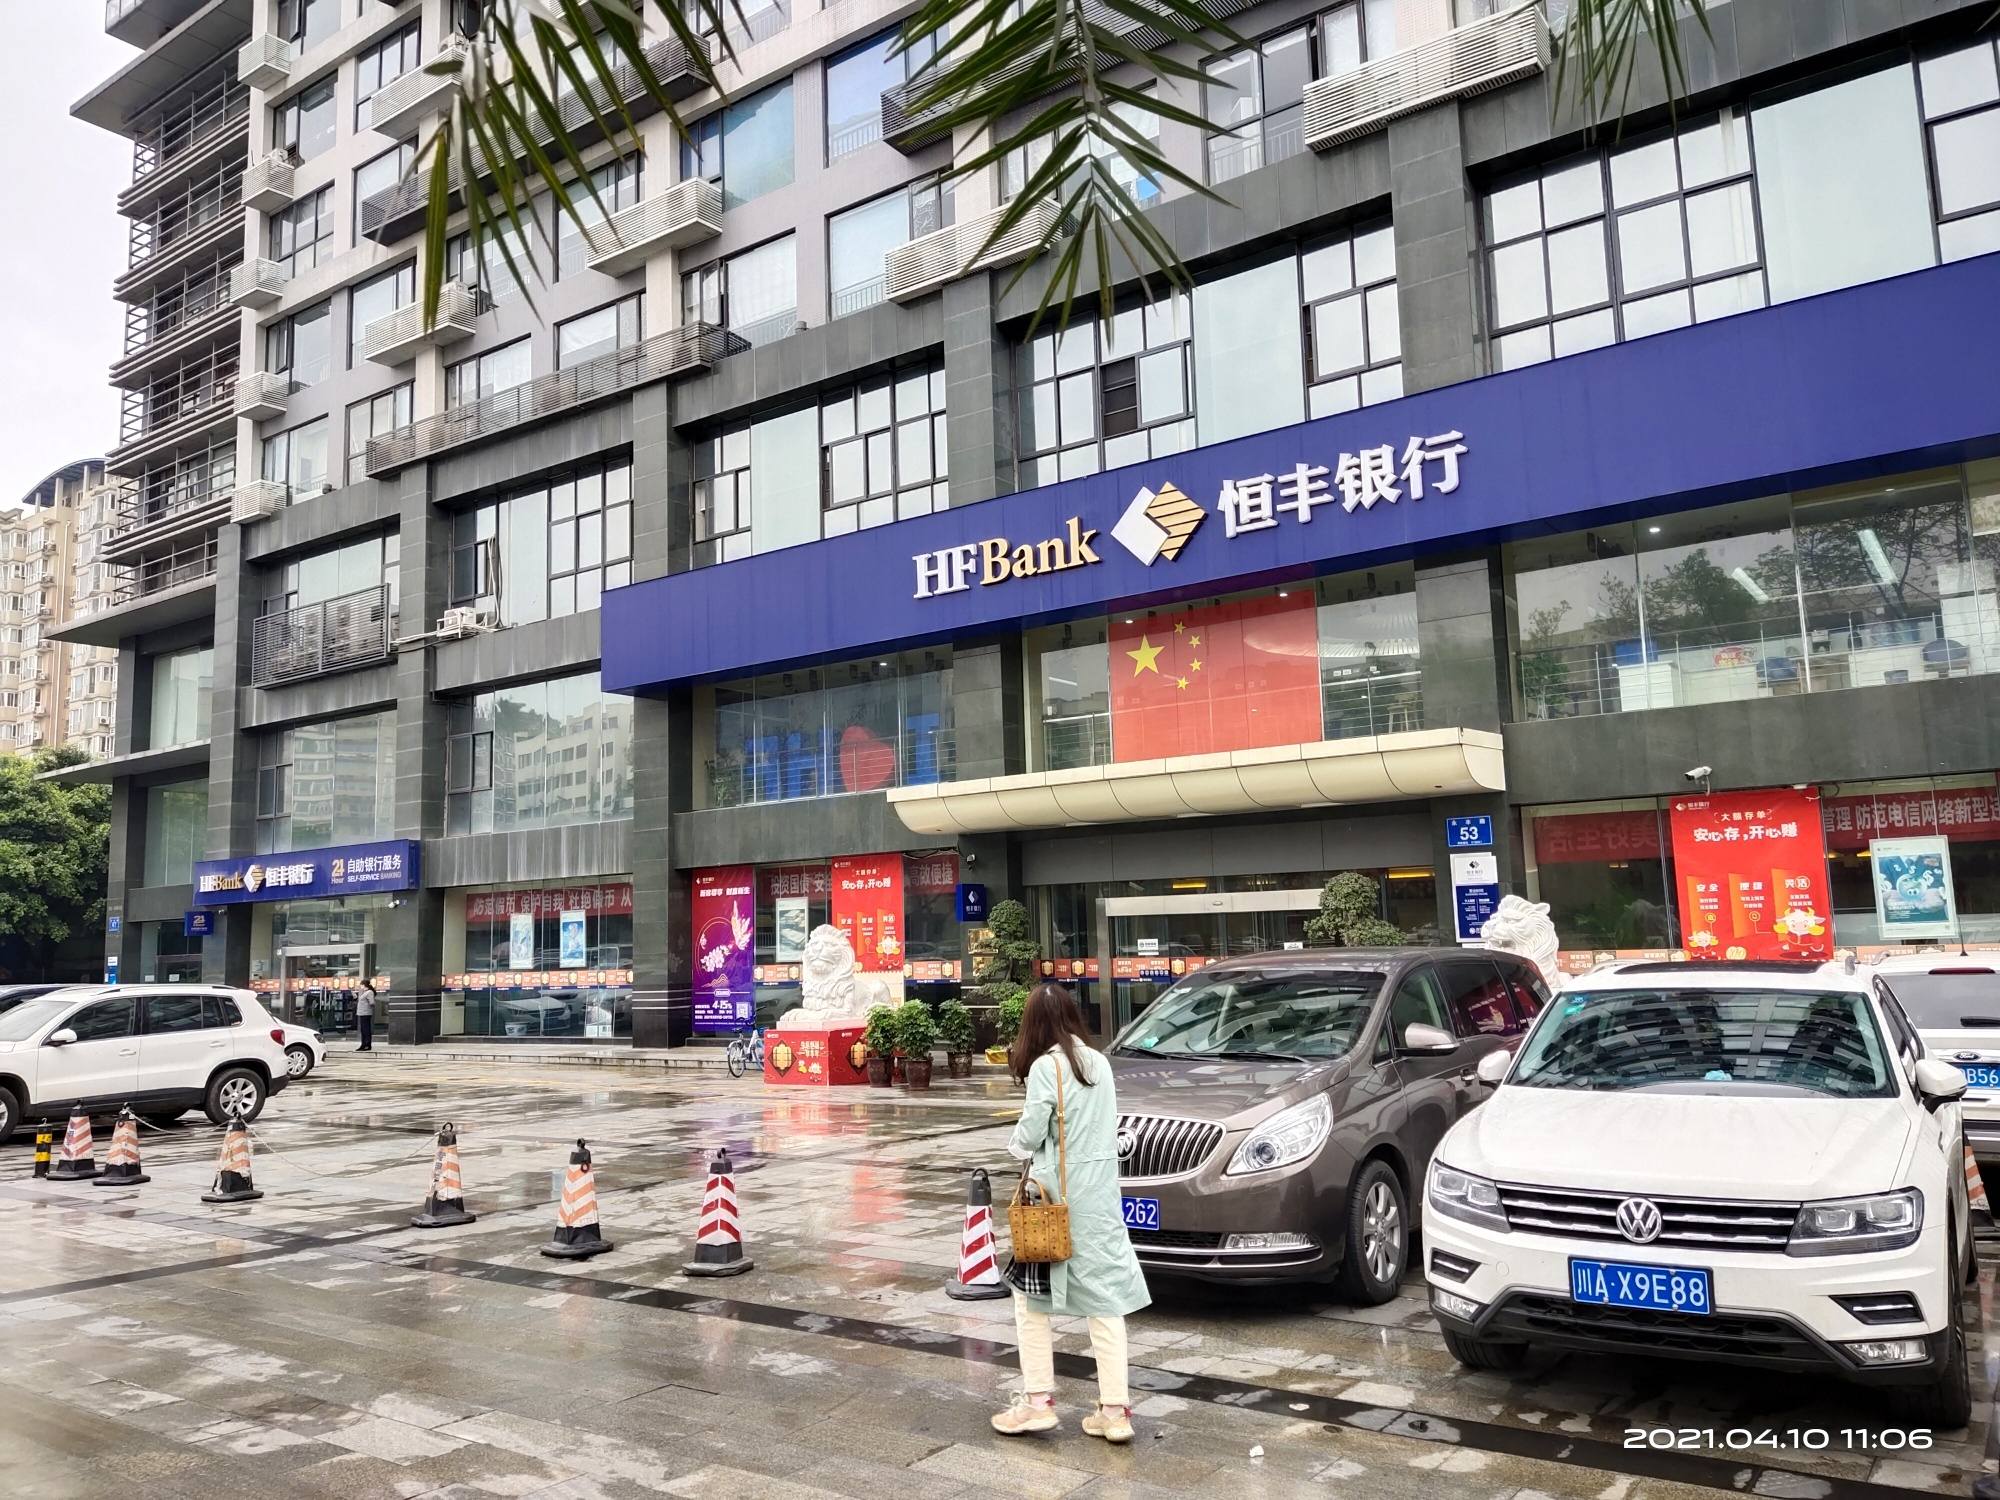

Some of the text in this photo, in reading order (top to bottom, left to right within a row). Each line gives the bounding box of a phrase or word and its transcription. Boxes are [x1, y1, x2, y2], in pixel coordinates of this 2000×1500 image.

[1217, 430, 1468, 538] 恒丰银行
[912, 516, 1100, 599] HFBank
[1460, 826, 1479, 840] 53
[331, 858, 345, 877] 24
[347, 854, 402, 874] 自助银行服务
[911, 862, 954, 886] 高效便捷
[199, 872, 241, 892] HFBank
[265, 864, 315, 888] 恒丰银行
[347, 873, 380, 883] SELF-SERVICE
[521, 893, 565, 913] 保护自我
